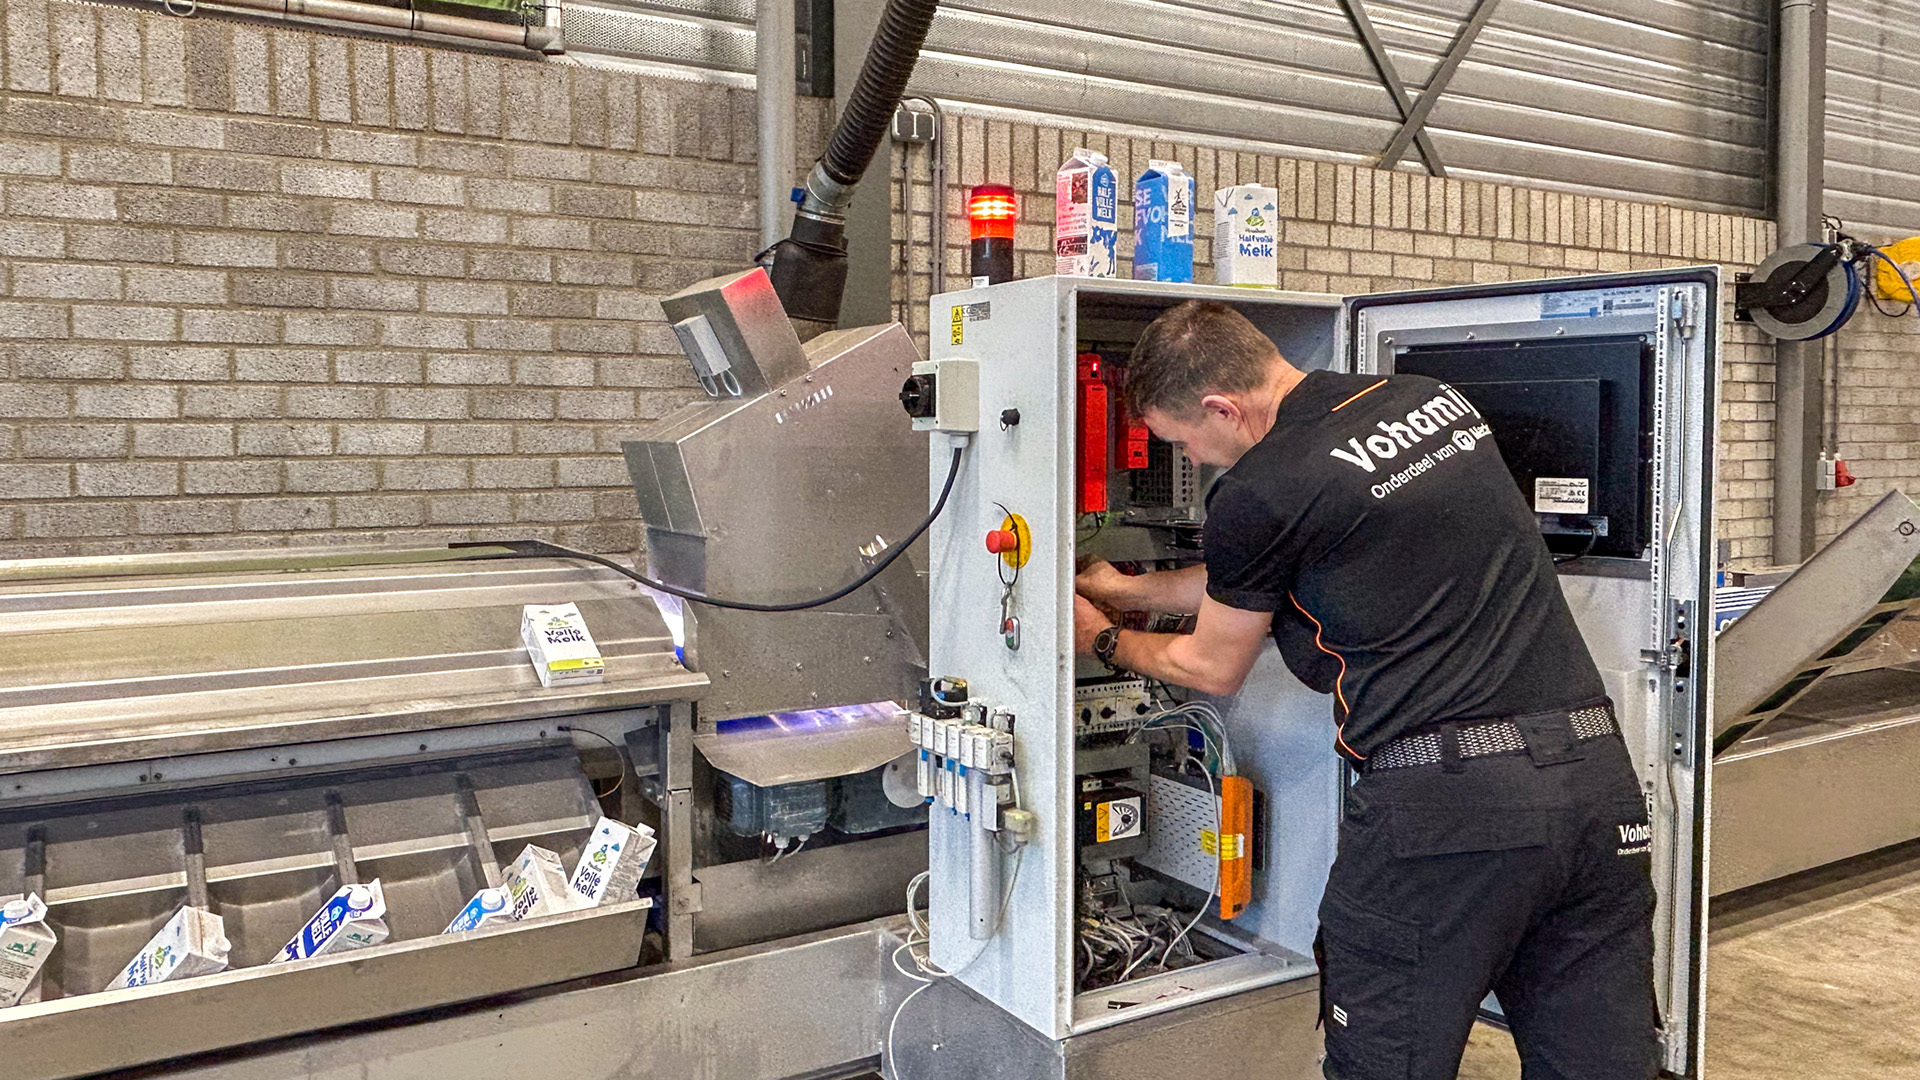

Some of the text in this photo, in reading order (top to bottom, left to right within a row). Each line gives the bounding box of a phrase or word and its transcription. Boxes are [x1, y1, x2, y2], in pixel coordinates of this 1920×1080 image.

[1240, 243, 1273, 257] Melk
[1370, 455, 1436, 499] Onderdeel
[1432, 443, 1458, 461] van
[544, 628, 581, 638] Volle
[546, 634, 586, 644] Melk
[580, 866, 601, 887] Volle
[573, 877, 597, 900] Melk
